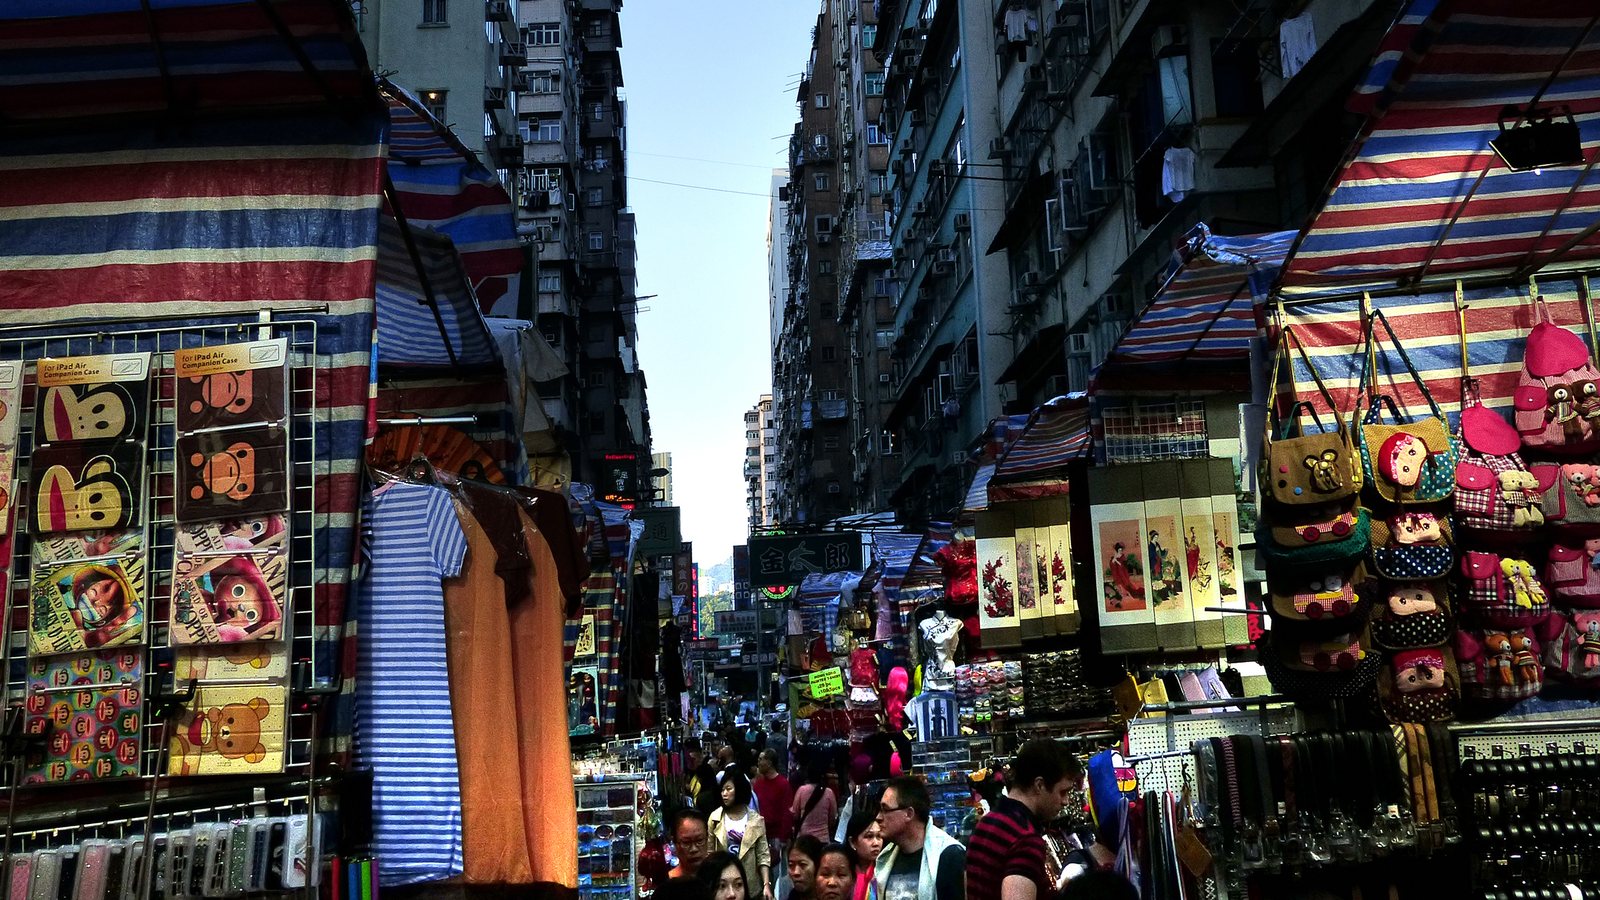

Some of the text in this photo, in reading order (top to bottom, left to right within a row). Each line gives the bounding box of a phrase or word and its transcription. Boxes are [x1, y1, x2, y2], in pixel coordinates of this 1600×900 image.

[195, 353, 210, 361] iPad
[182, 360, 221, 369] Companion
[44, 371, 82, 379] Companion
[759, 539, 851, 574] 金太郎
[60, 612, 71, 625] OR
[199, 608, 208, 620] OR
[931, 716, 947, 738] 10
